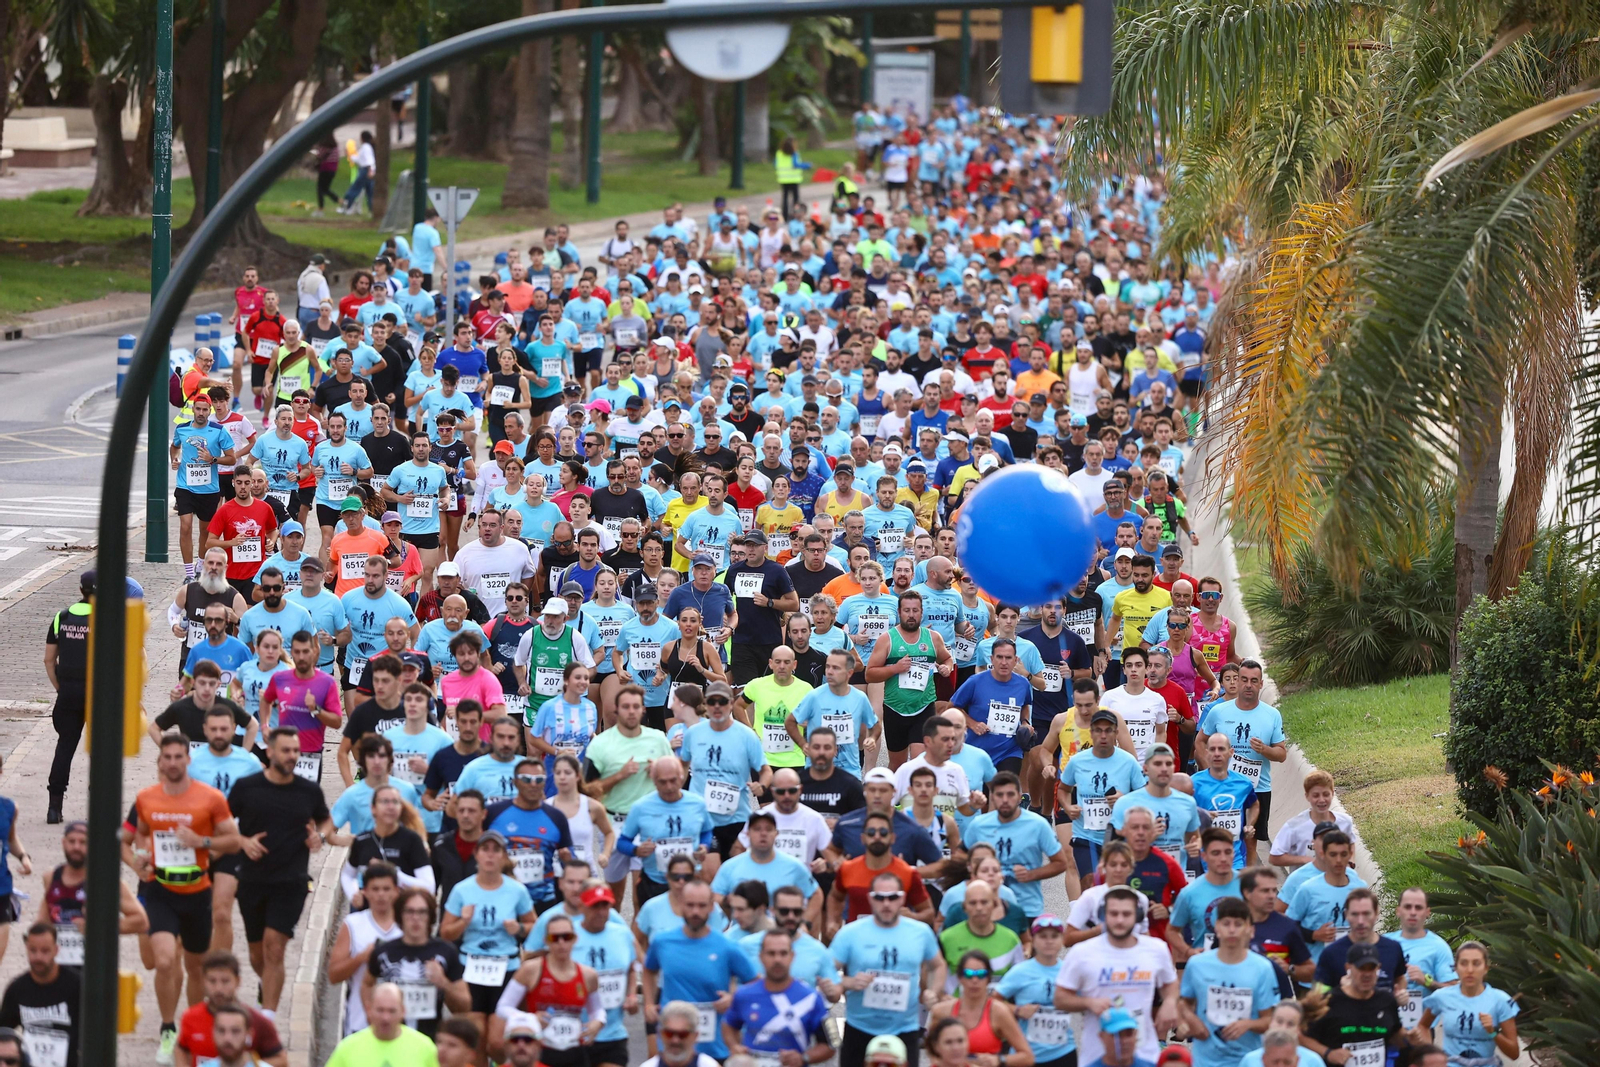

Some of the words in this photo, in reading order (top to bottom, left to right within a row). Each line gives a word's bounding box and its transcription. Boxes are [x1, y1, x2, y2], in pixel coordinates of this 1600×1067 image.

[346, 561, 365, 569] 6512
[487, 580, 506, 588] 3220
[928, 614, 954, 622] nerja
[956, 642, 969, 652] 192
[636, 651, 657, 659] 1688
[908, 671, 923, 680] 145
[1043, 672, 1058, 681] 265
[544, 677, 560, 686] 207
[994, 713, 1016, 723] 3382
[828, 723, 849, 732] 6101
[768, 734, 790, 742] 1706
[1232, 763, 1258, 777] 11898
[710, 791, 734, 802] 6573
[1213, 820, 1236, 829] 1863
[775, 839, 800, 848] 6798
[1216, 1000, 1244, 1011] 1193
[1354, 1052, 1380, 1065] 1838
